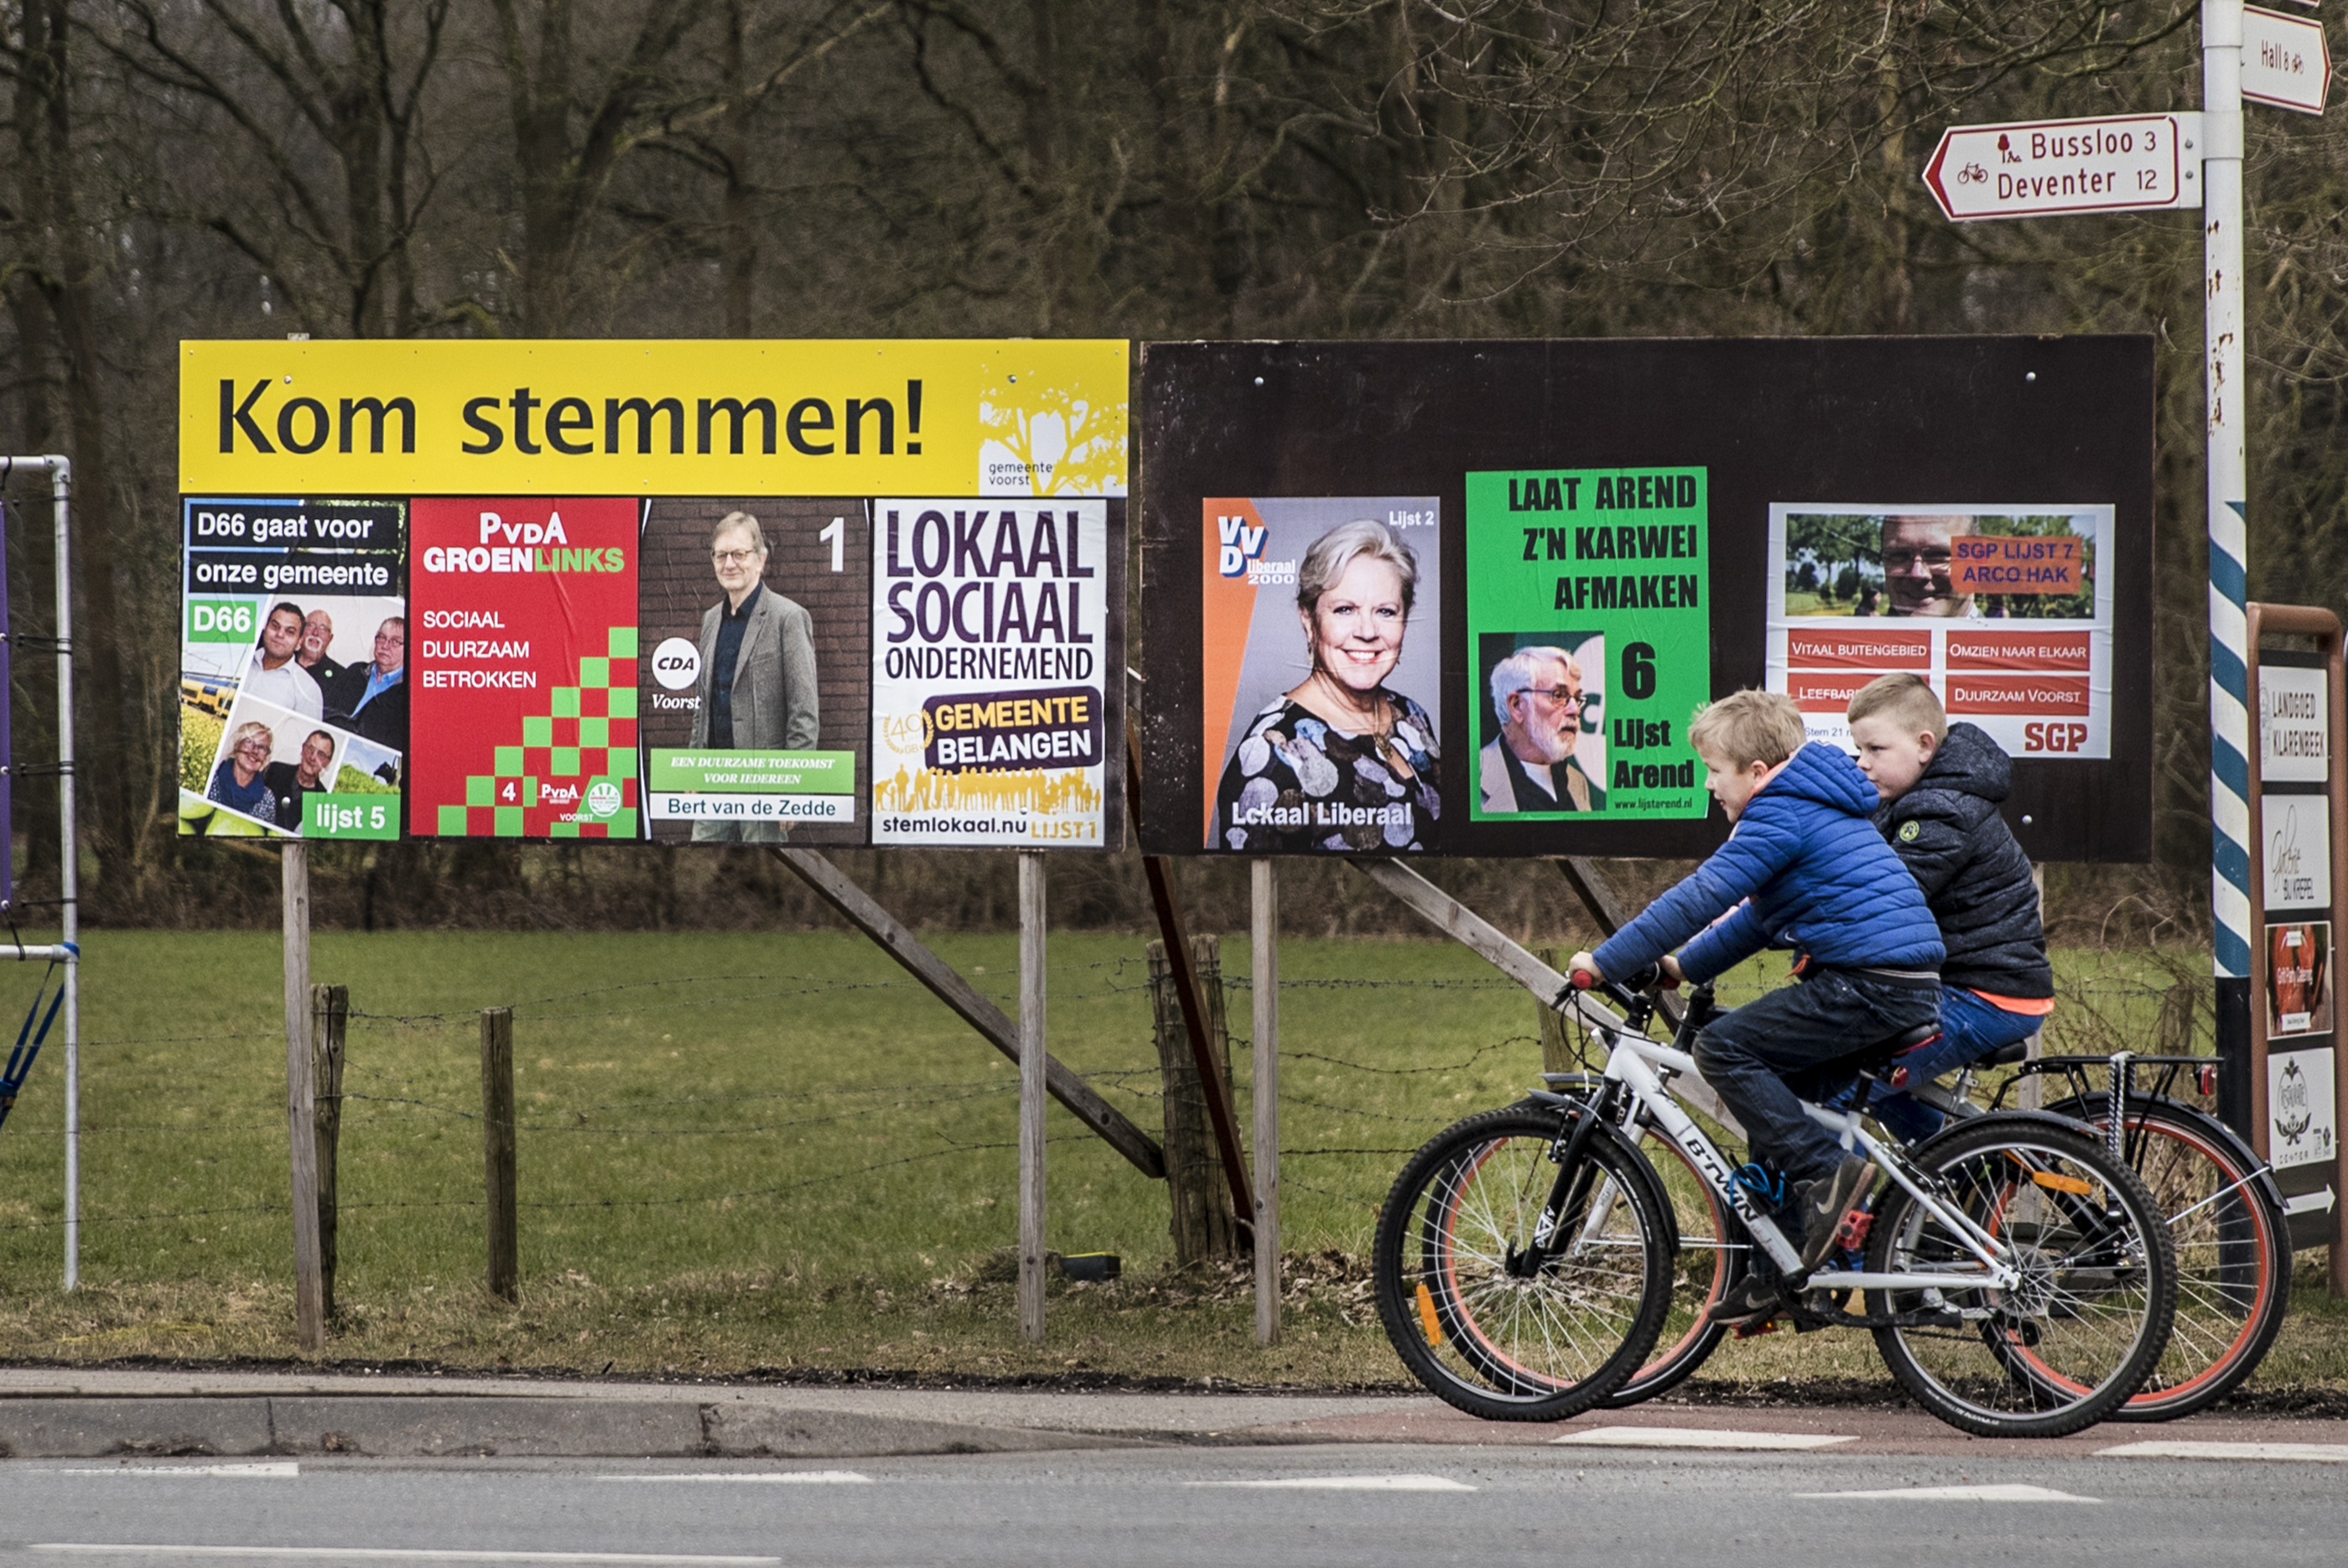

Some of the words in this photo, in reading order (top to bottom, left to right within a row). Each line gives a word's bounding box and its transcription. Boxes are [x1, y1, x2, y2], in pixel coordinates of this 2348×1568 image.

[2261, 39, 2282, 70] Hall
[2283, 50, 2289, 72] 8
[2031, 127, 2133, 160] Bussloo
[2143, 131, 2157, 153] 3
[1997, 167, 2117, 200] Deventer
[2137, 169, 2158, 191] 12
[219, 379, 416, 455] Kom
[462, 378, 923, 456] stemmen!
[989, 461, 1053, 475] gemeente
[989, 474, 1030, 485] voorst
[1509, 477, 1582, 511] LAAT
[1595, 475, 1697, 510] AREND
[197, 511, 246, 537] D66
[252, 515, 308, 543] gaat
[314, 517, 374, 539] voor
[1389, 510, 1422, 529] Lijst
[1424, 511, 1436, 527] 2
[819, 517, 845, 573] 1
[886, 510, 1095, 579] LOKAAL
[1522, 527, 1566, 561] Z'N
[1575, 524, 1698, 560] KARWEI
[1956, 543, 1999, 560] SGP
[2003, 543, 2057, 560] LIJST
[2063, 543, 2075, 560] 7
[423, 546, 626, 574] GROENLINKS
[196, 563, 257, 584] onze
[263, 563, 390, 590] gemeente
[1247, 574, 1296, 585] 2000
[1961, 566, 2022, 584] ARCO
[2025, 566, 2070, 583] HAK
[1554, 574, 1699, 610] AFMAKEN
[193, 605, 251, 634] D66
[423, 610, 506, 629] SOCIAAL
[886, 580, 1094, 644] SOCIAAL
[423, 641, 530, 658] DUURZAAM
[885, 646, 1094, 681] ONDERNEMEND
[657, 657, 695, 671] CDA
[1621, 641, 1657, 700] 6
[423, 670, 538, 688] BETROKKEN
[1799, 686, 1861, 700] LEEFBAR
[652, 693, 702, 710] Voorst
[935, 695, 1089, 732] GEMEENTE
[2272, 690, 2317, 720] LANDGOED
[891, 713, 923, 742] 40
[1613, 719, 1672, 750] Lijst
[1804, 726, 1830, 736] Stem
[1831, 727, 1843, 737] 21
[2023, 722, 2088, 752] SGP
[937, 729, 1092, 766] BELANGEN
[2272, 728, 2326, 758] KLARENBEEK
[670, 755, 697, 768] EEN
[697, 756, 766, 769] DUURZAME
[767, 757, 836, 770] TOEKOMST
[1613, 759, 1696, 789] Arend
[501, 781, 517, 802] 4
[704, 772, 739, 784] VOOR
[740, 773, 803, 785] IEDEREEN
[315, 802, 364, 834] lijst
[369, 805, 387, 830] 5
[559, 812, 595, 823] VOORST
[668, 797, 707, 815] Bert
[712, 802, 745, 815] van
[751, 799, 773, 816] de
[777, 799, 837, 817] Zedde
[1231, 802, 1311, 826] Lokaal
[1317, 802, 1412, 826] Liberaal
[1613, 797, 1693, 813] www.lijstarend.nl
[882, 816, 1028, 834] stemlokaal.nu
[1031, 820, 1085, 839] LIJST
[1088, 821, 1097, 839] 1
